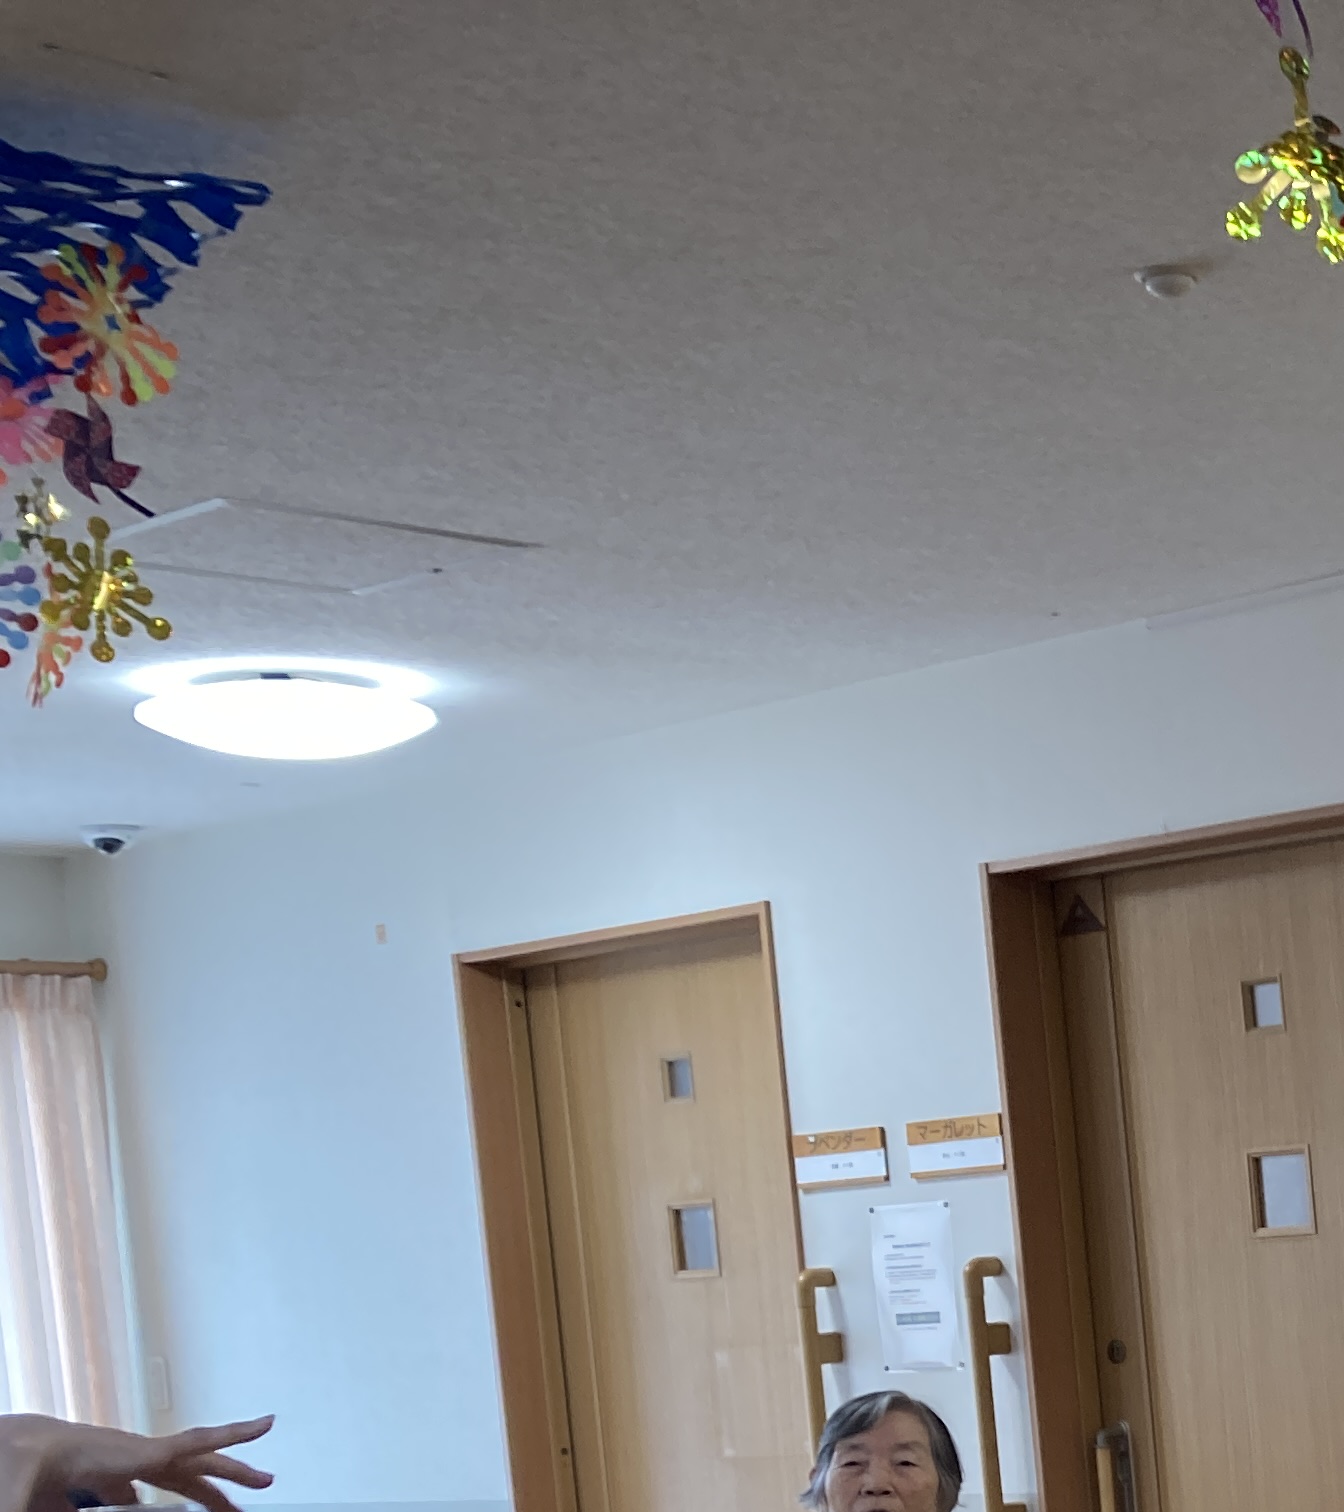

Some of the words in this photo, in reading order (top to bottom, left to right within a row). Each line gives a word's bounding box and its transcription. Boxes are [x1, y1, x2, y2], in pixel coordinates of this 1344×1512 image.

[916, 1116, 987, 1141] マーガレット
